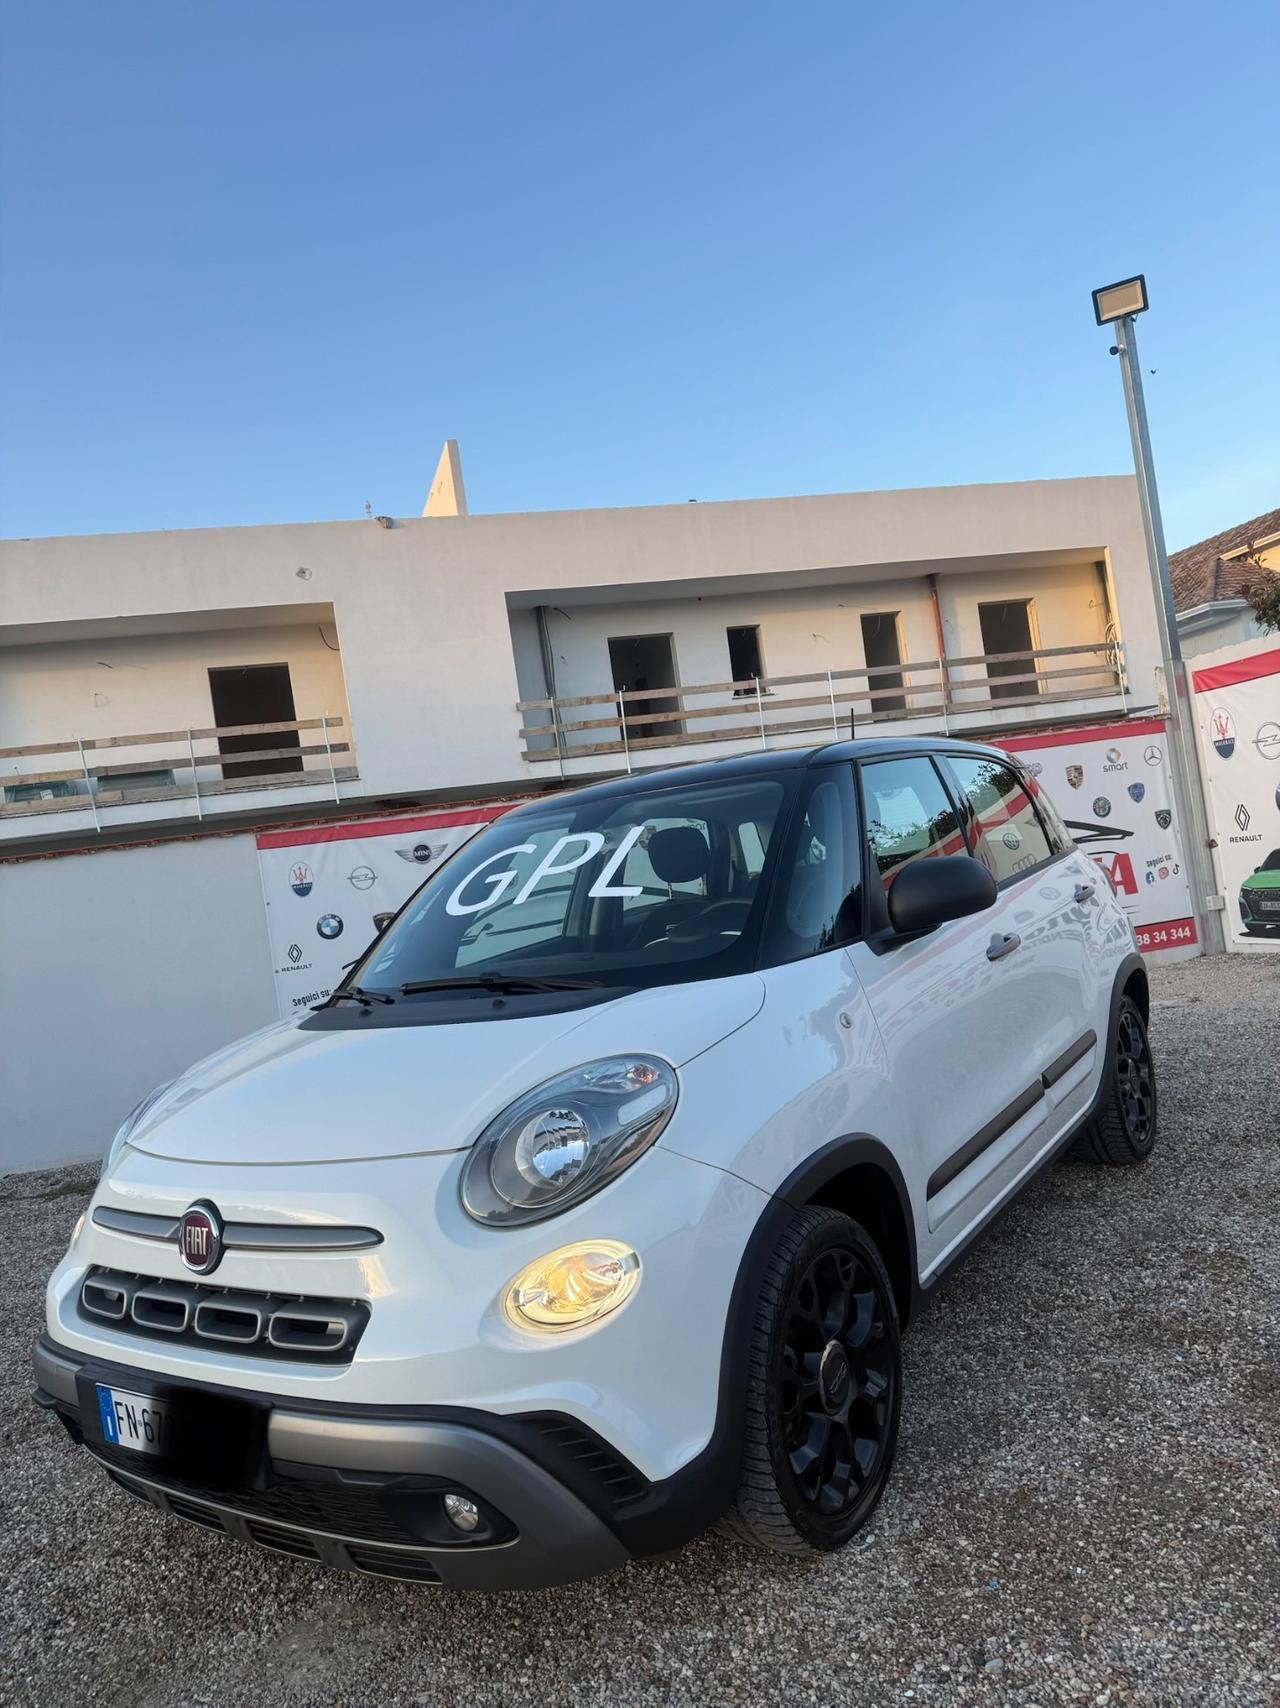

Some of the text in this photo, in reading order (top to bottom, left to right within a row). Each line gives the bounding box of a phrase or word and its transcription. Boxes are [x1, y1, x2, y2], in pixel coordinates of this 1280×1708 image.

[1103, 762, 1129, 773] smart
[1229, 834, 1263, 843] RENAULT
[446, 825, 645, 916] GPL
[1153, 931, 1168, 943] 34
[1170, 926, 1192, 940] 344
[281, 963, 312, 972] RENAULT
[186, 1225, 209, 1255] FIAT
